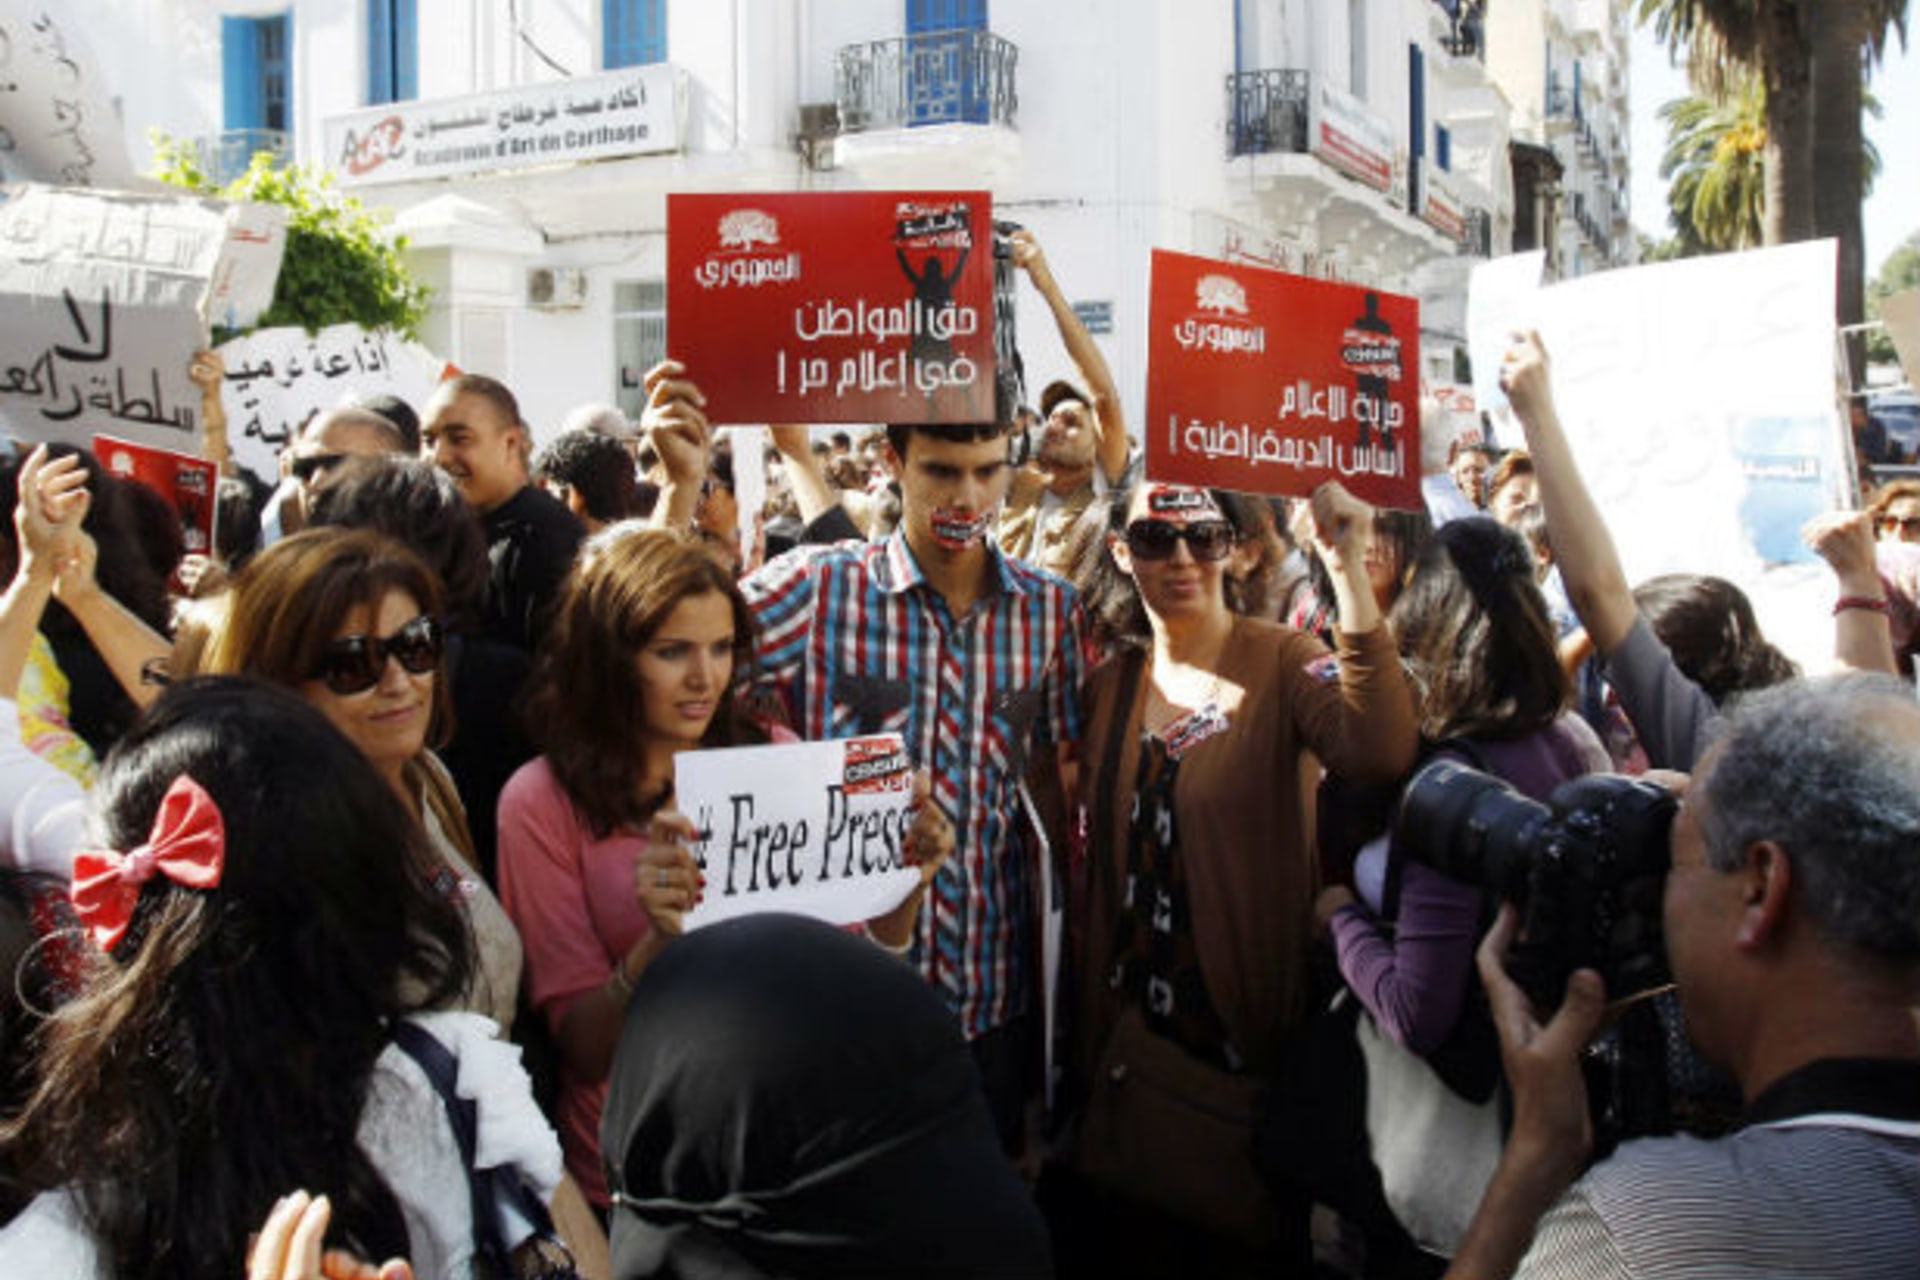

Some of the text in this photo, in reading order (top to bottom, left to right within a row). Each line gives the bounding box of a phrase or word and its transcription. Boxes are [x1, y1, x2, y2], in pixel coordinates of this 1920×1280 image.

[565, 121, 649, 151] Carthage
[54, 285, 111, 362] لا
[796, 299, 977, 344] حق المواطن
[798, 357, 829, 396] حر
[836, 350, 907, 398] إعلام
[914, 350, 977, 398] في
[90, 367, 195, 433] سلطة
[1352, 390, 1404, 433] حرية
[723, 793, 808, 896] Free
